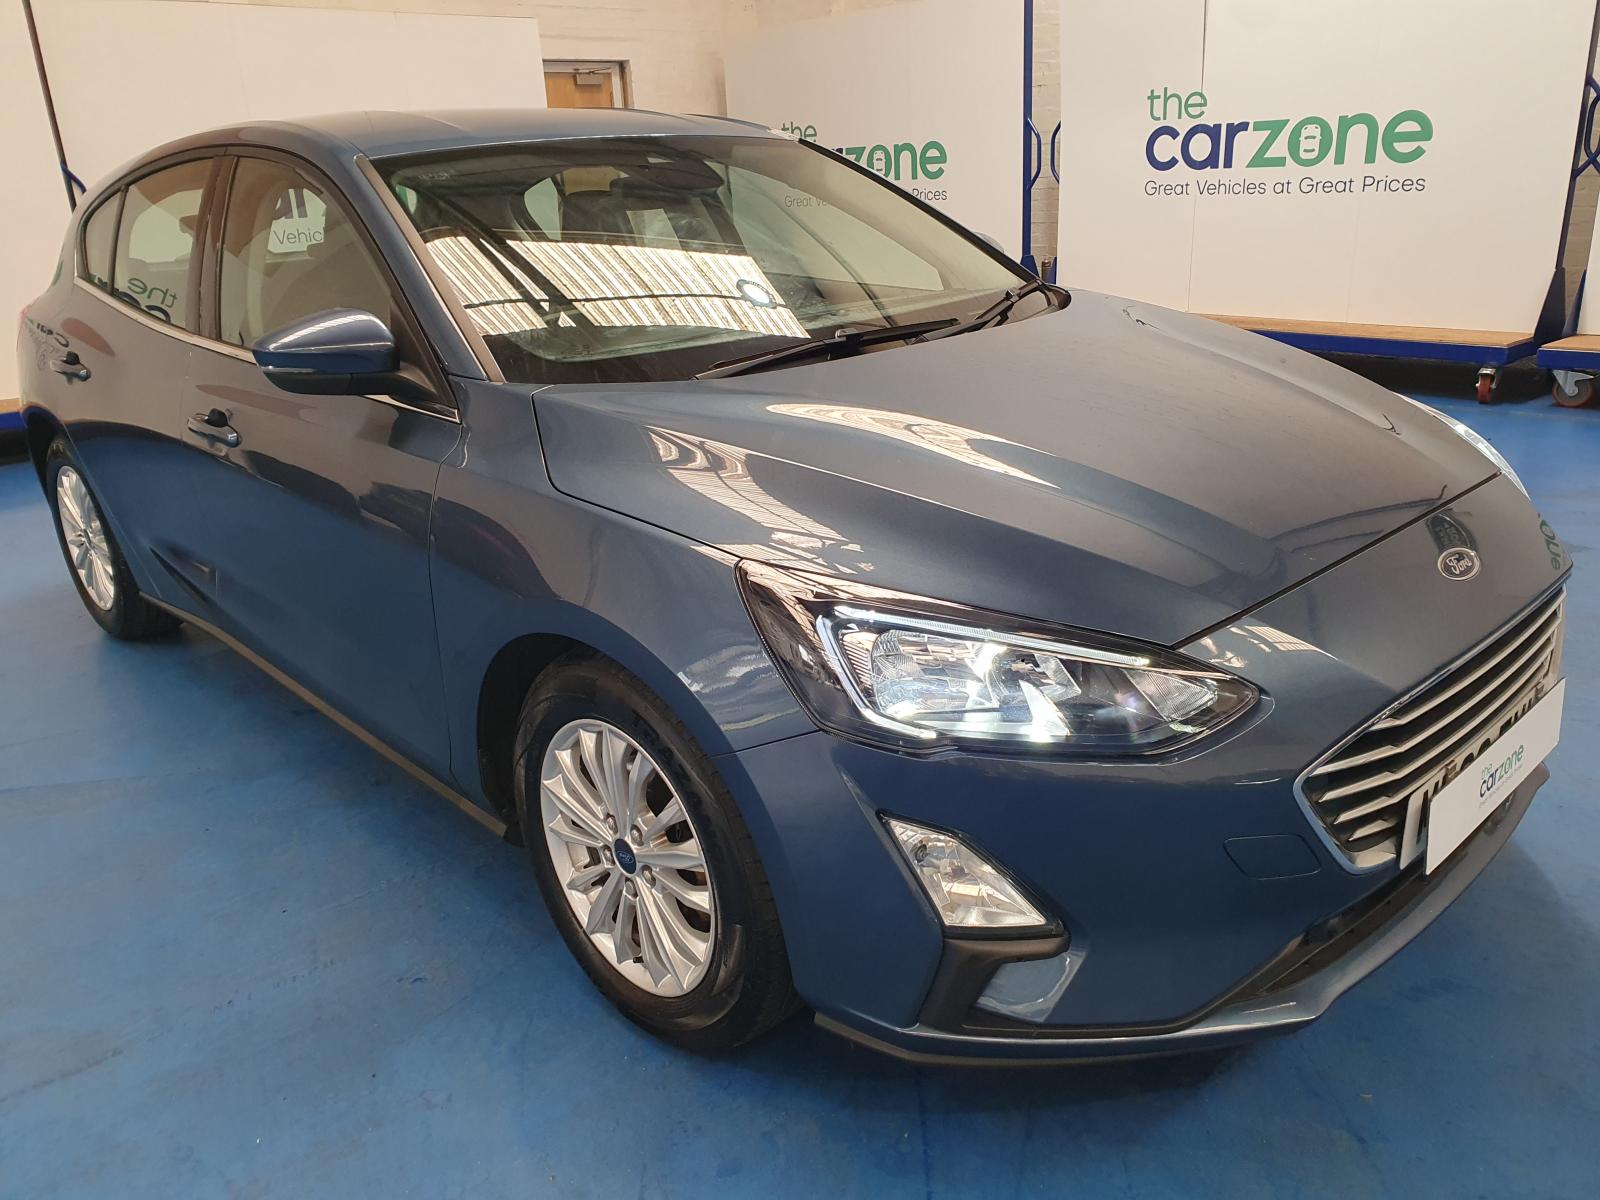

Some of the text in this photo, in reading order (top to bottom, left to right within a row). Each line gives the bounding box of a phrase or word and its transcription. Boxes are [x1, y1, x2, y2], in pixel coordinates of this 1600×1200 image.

[1147, 87, 1208, 121] the
[1145, 109, 1434, 172] carzone
[1144, 175, 1427, 196] Great Vehicles at Great Prices
[784, 195, 812, 208] Great
[912, 188, 948, 201] Prices
[273, 228, 323, 245] Vehic
[1446, 554, 1473, 575] Ford
[1480, 744, 1524, 798] carzone
